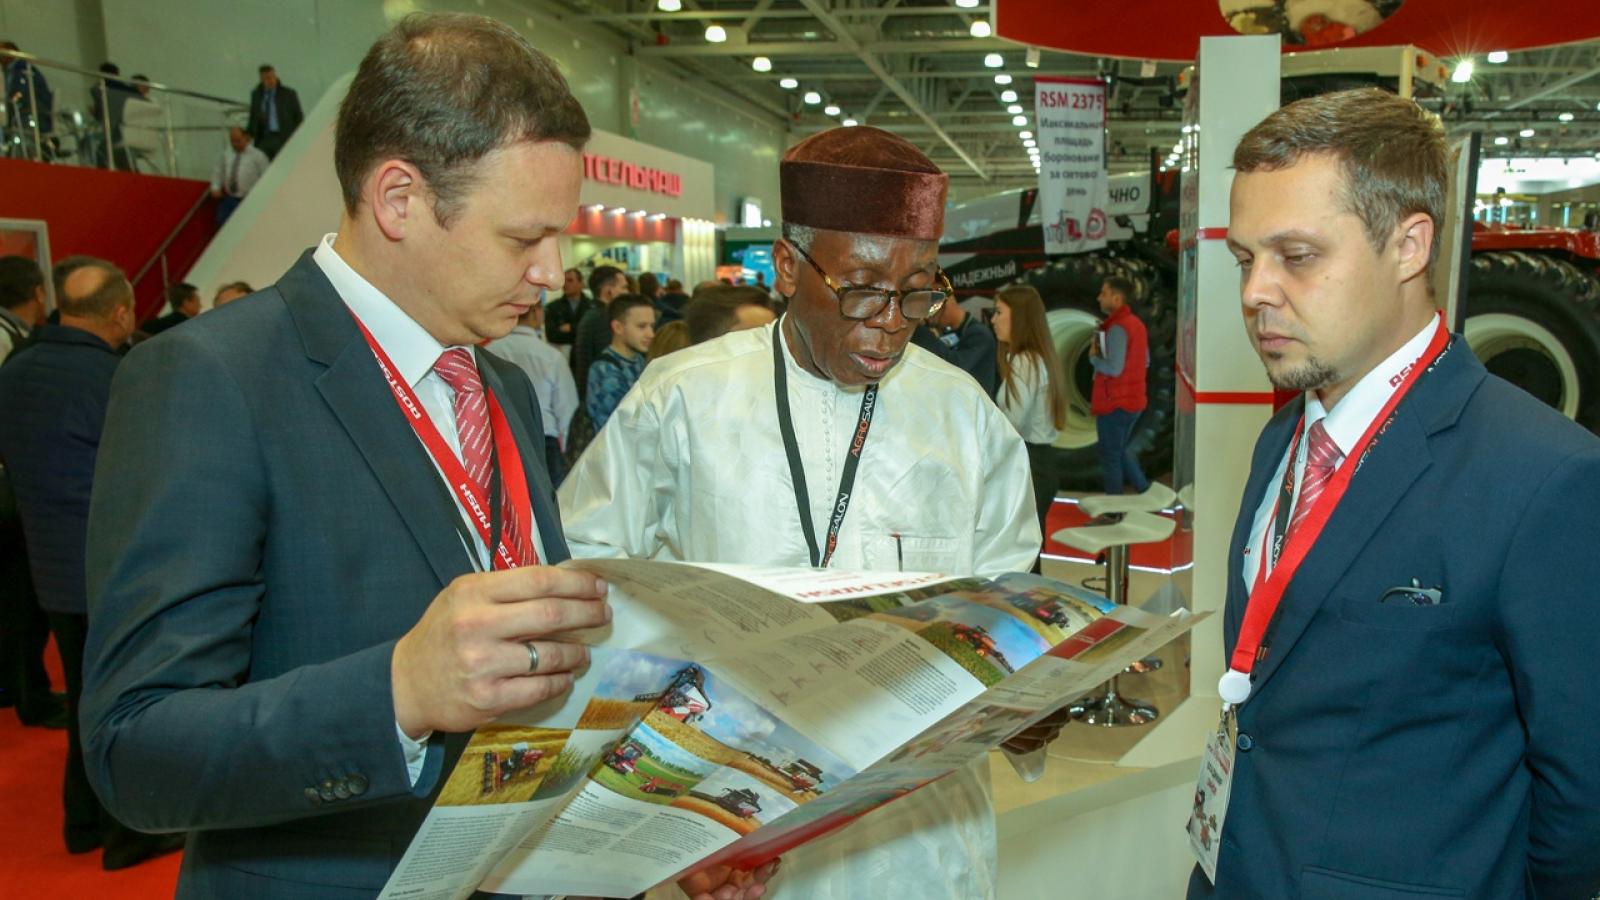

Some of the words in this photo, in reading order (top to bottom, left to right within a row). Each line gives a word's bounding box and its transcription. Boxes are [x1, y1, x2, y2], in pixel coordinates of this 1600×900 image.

[1039, 90, 1069, 108] RSM
[1072, 92, 1105, 110] 2375
[952, 258, 1017, 289] НАДЕЖНЫЙ
